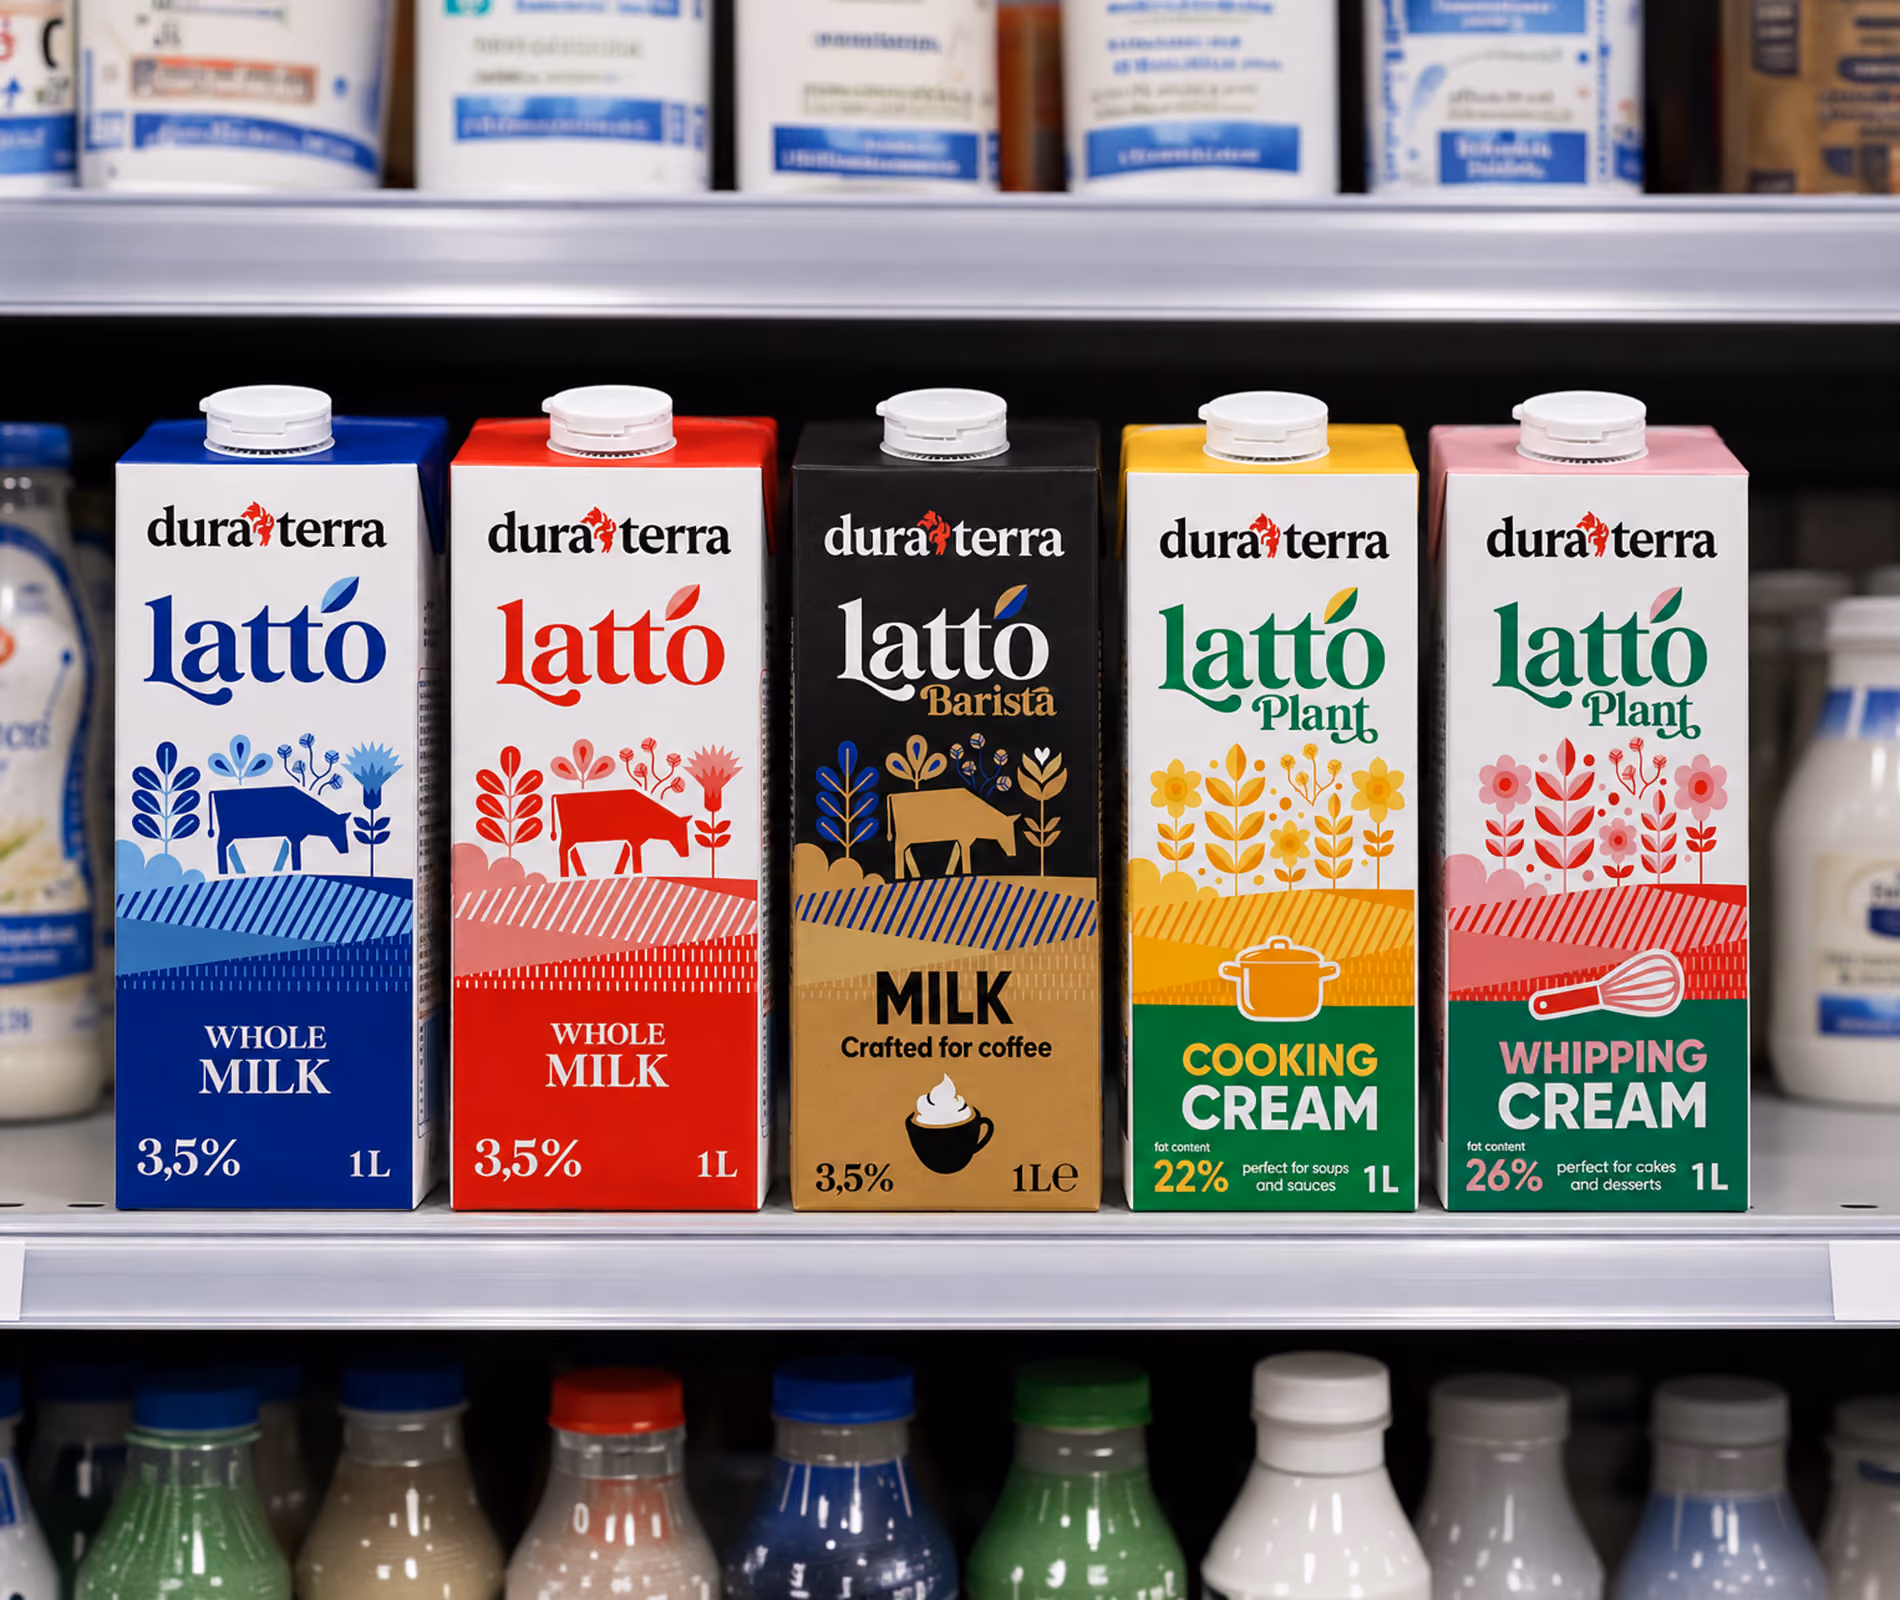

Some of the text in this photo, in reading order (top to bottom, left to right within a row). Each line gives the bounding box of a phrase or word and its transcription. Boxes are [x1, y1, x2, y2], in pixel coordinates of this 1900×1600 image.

[920, 684, 1057, 717] Barista
[1582, 690, 1702, 740] Plant
[1252, 694, 1379, 745] Plant
[876, 971, 1014, 1025] MILK
[204, 1025, 327, 1049] WHOLE
[550, 1022, 666, 1045] WHOLE
[841, 1036, 1052, 1058] Crafted for coffee
[545, 1053, 670, 1088] MILK
[1182, 1042, 1378, 1077] COOKING
[1499, 1039, 1708, 1075] WHIPPING
[198, 1059, 332, 1094] MILK
[1182, 1084, 1378, 1131] CREAM
[1498, 1082, 1707, 1130] CREAM
[137, 1137, 241, 1181] 3,5%
[474, 1137, 582, 1182] 3,5%
[1154, 1141, 1211, 1153] fat content
[1467, 1141, 1526, 1152] fat content
[350, 1150, 391, 1177] 1L
[697, 1150, 738, 1178] 1L
[815, 1162, 894, 1196] 3,5%
[1154, 1159, 1229, 1193] 22%
[1242, 1161, 1350, 1177] perfect for soups
[1363, 1165, 1399, 1193] 1L
[1466, 1158, 1543, 1192] 26%
[1557, 1160, 1677, 1176] perfect for cakes
[1691, 1162, 1729, 1191] 1L
[1256, 1179, 1337, 1192] and sauces
[1570, 1177, 1662, 1191] and desserts
